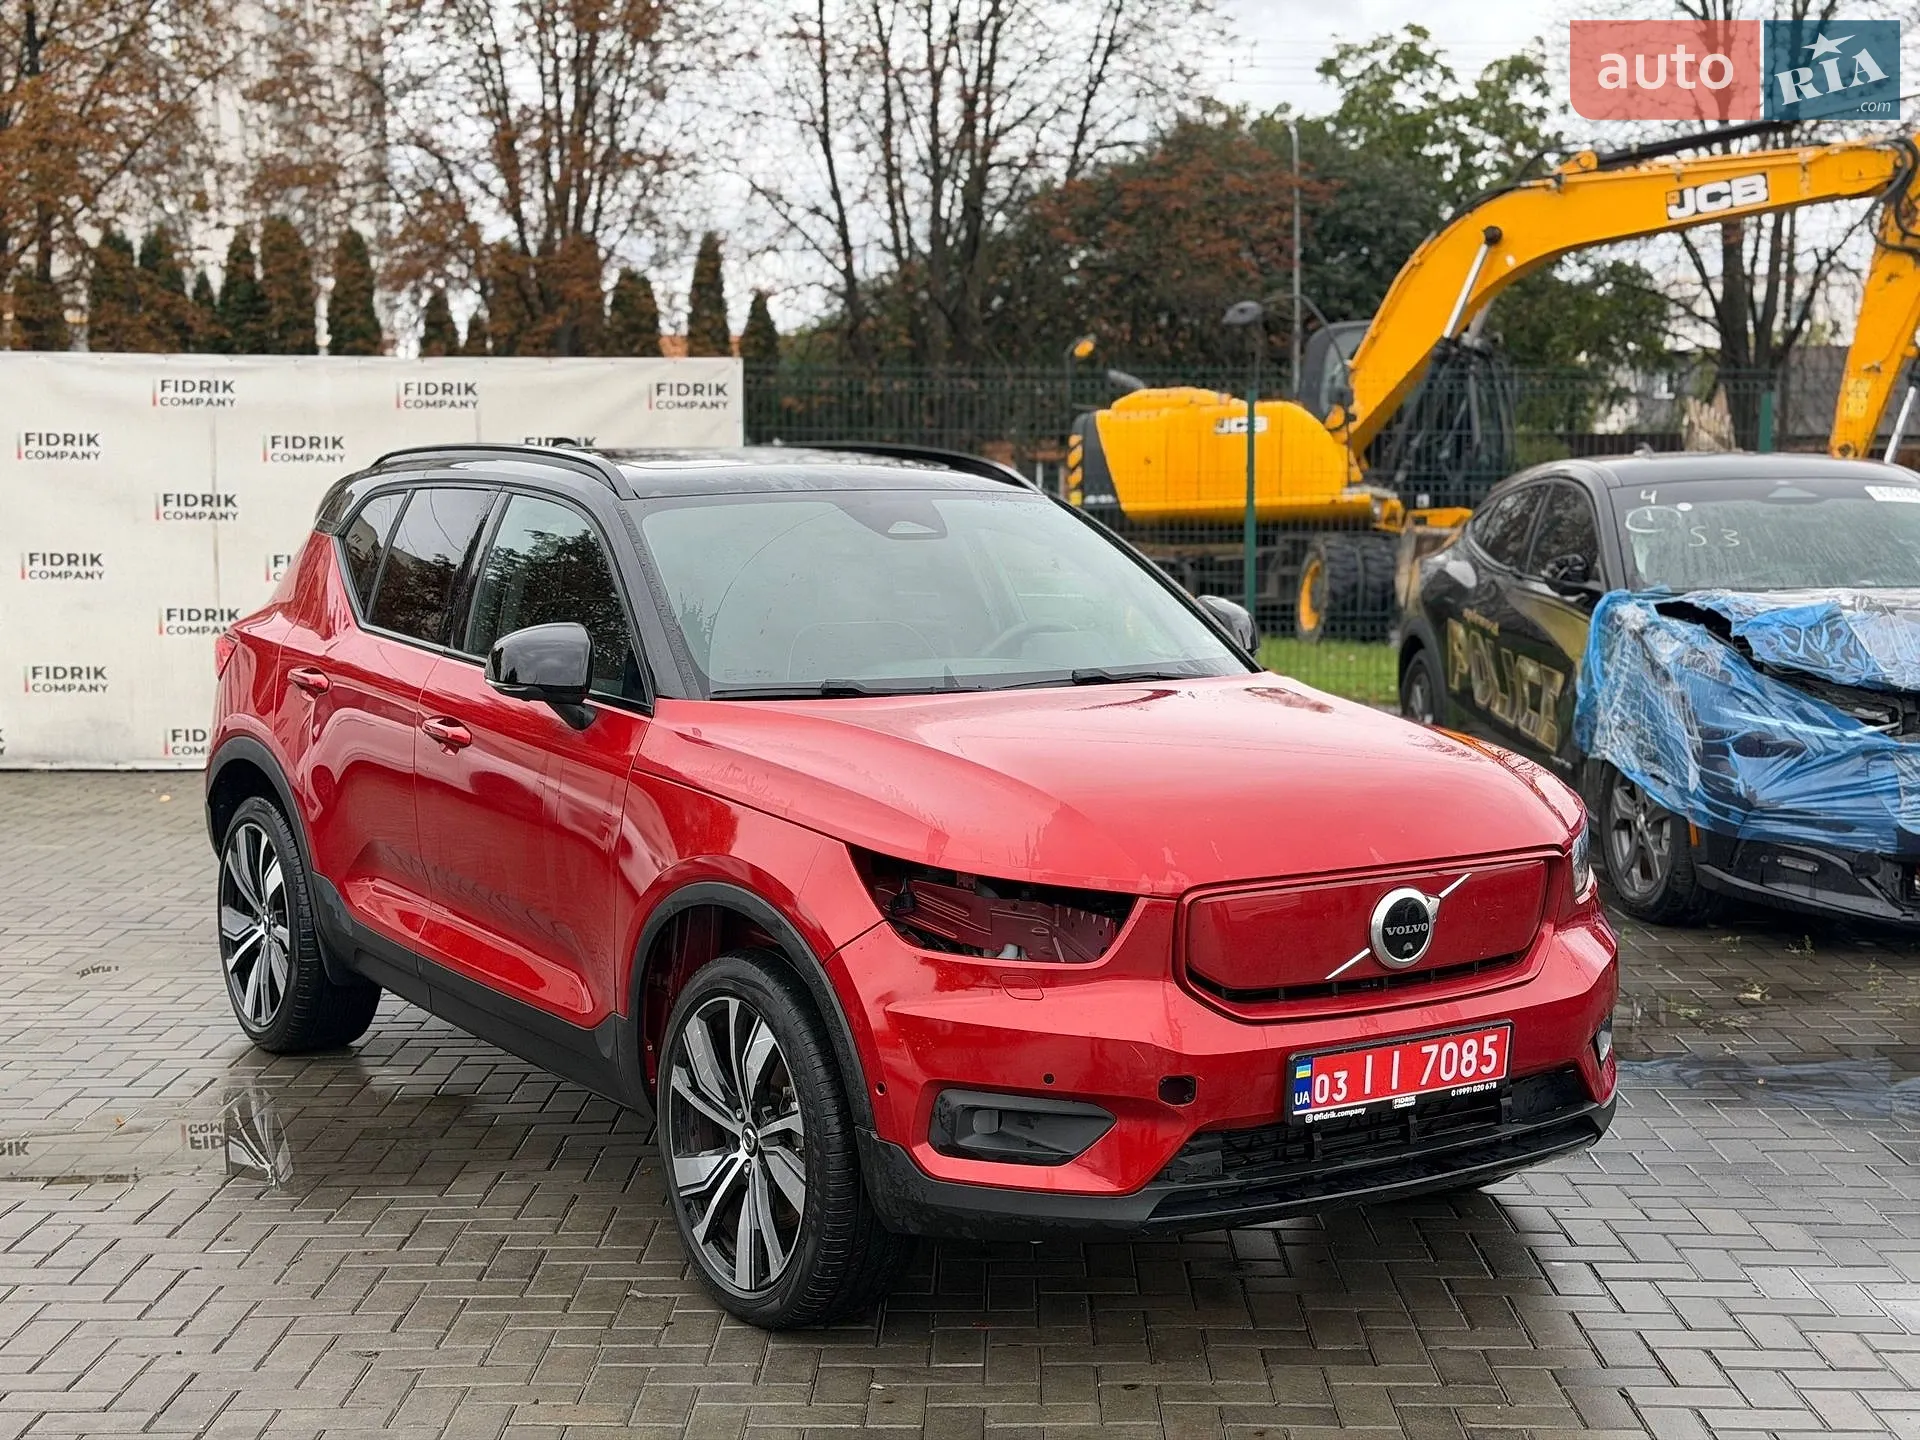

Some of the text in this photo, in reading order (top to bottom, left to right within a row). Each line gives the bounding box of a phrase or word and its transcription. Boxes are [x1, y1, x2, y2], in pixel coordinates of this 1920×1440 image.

[1666, 173, 1769, 220] JCB
[160, 379, 236, 394] FIDRIK
[403, 382, 478, 397] FIDRIK
[656, 382, 728, 397] FIDRIK
[160, 397, 236, 408] COMPANY
[403, 399, 478, 410] COMPANY
[656, 400, 728, 410] COMPANY
[24, 432, 100, 448] FIDRIK
[270, 435, 345, 450] FIDRIK
[24, 450, 101, 461] COMPANY
[270, 453, 345, 463] COMPANY
[163, 494, 238, 508] FIDRIK
[163, 511, 239, 521] COMPANY
[28, 552, 104, 567] FIDRIK
[28, 570, 104, 580] COMPANY
[166, 608, 240, 622] FIDRIK
[31, 666, 107, 680] FIDRIK
[31, 684, 108, 693] COMPANY
[171, 728, 207, 743] FID
[1385, 922, 1428, 936] VOLVO
[1314, 1070, 1349, 1104] 03
[1420, 1034, 1498, 1086] 7085
[1295, 1091, 1311, 1106] UA
[1313, 1107, 1367, 1122] @fidrik.company
